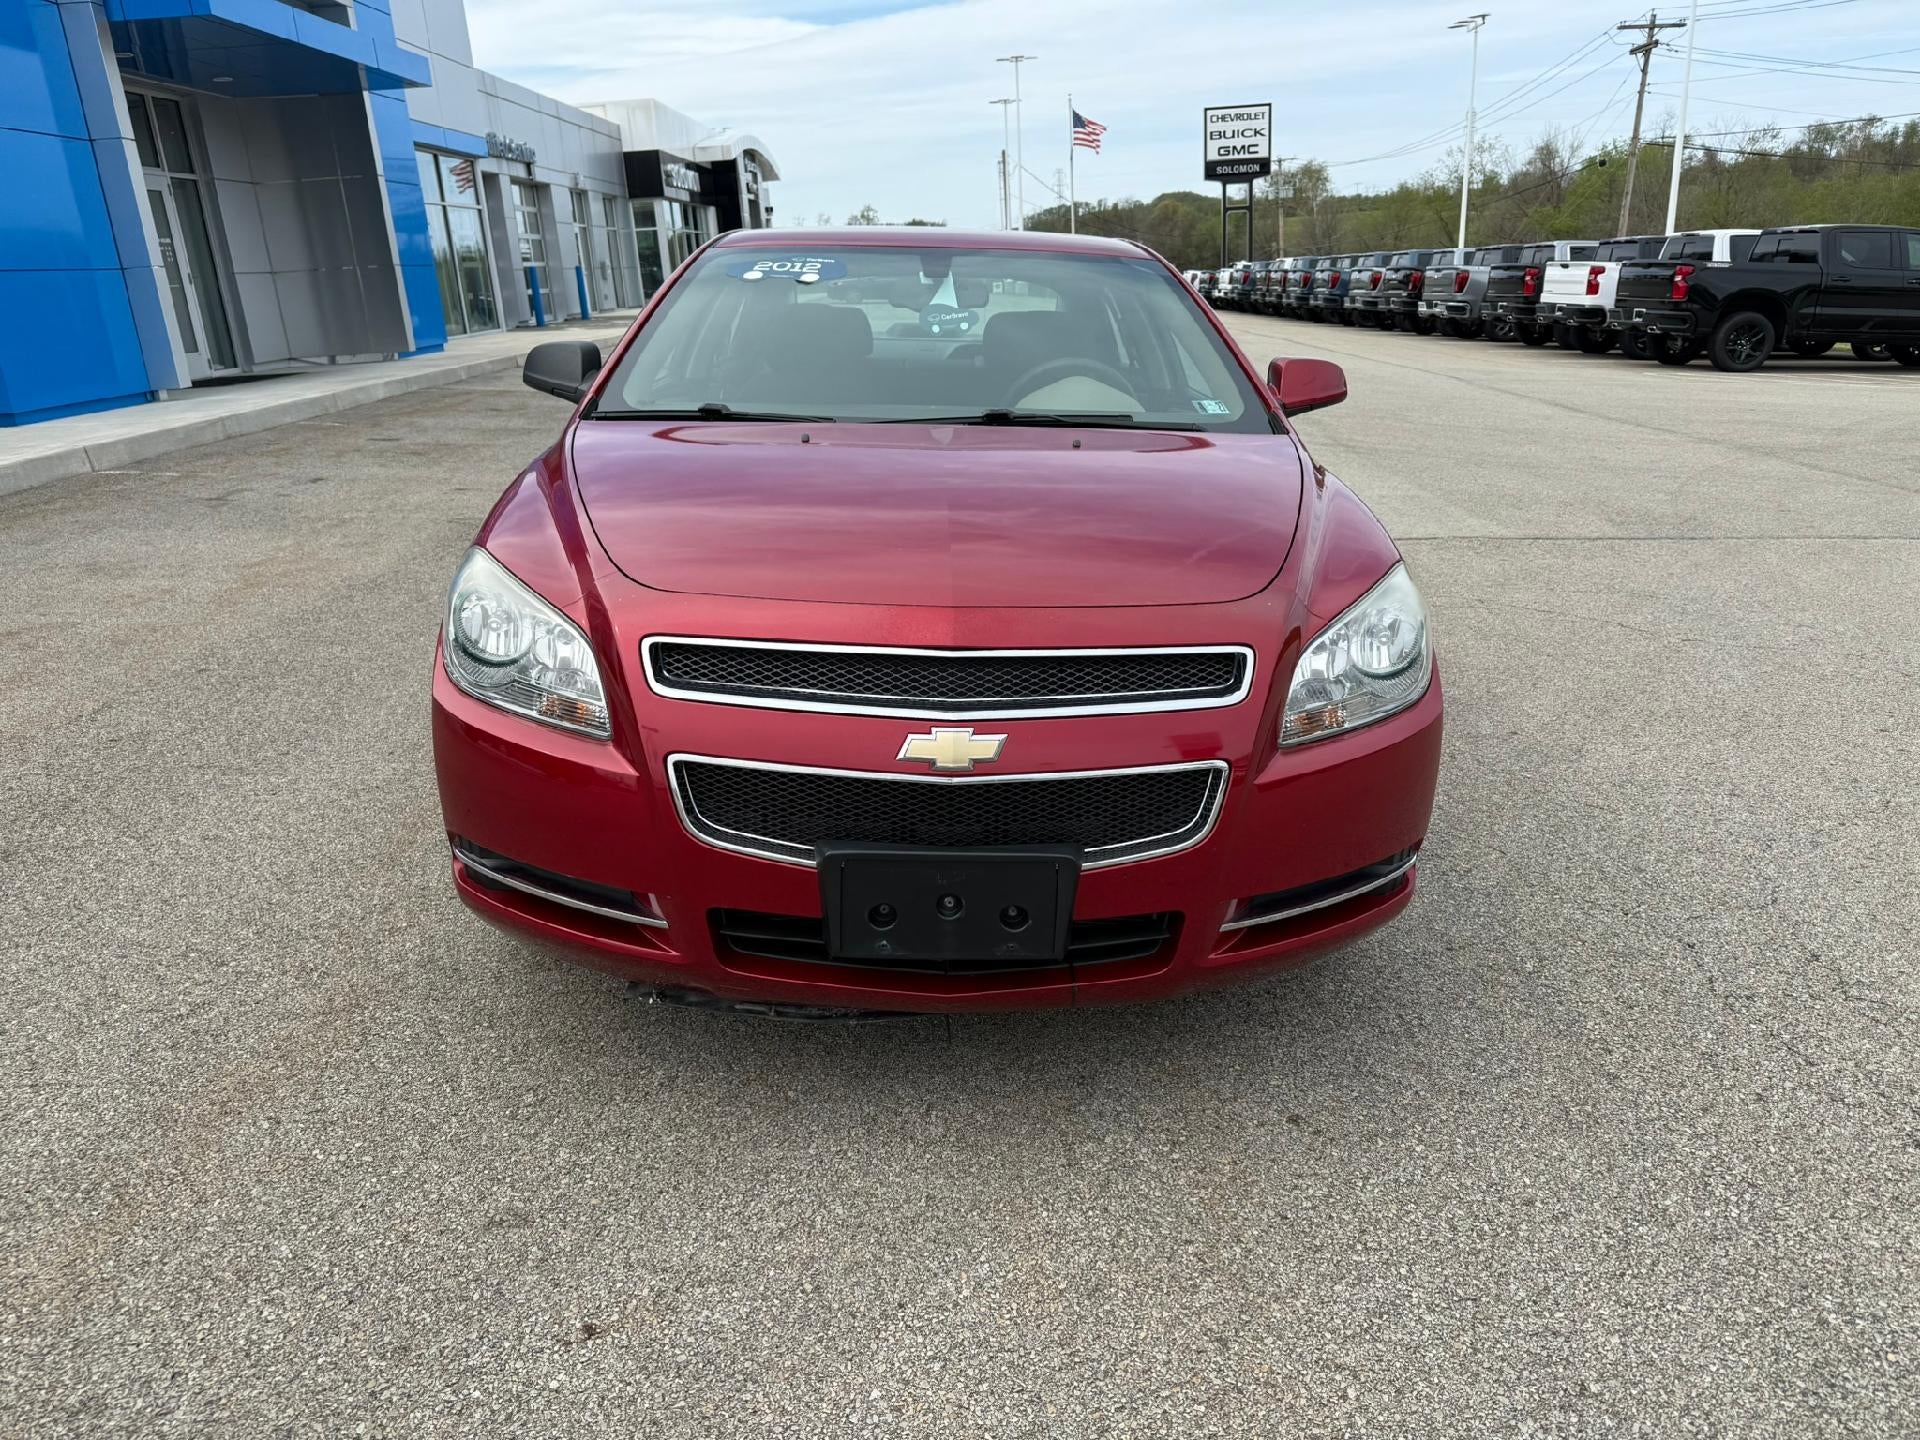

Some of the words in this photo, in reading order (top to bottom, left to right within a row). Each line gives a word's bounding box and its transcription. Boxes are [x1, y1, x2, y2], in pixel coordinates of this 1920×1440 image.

[1210, 112, 1266, 123] CHEVROLET
[1210, 128, 1266, 140] BUICK
[1217, 144, 1259, 157] GMC
[1216, 164, 1260, 174] SOLOMON
[753, 261, 821, 273] 2012
